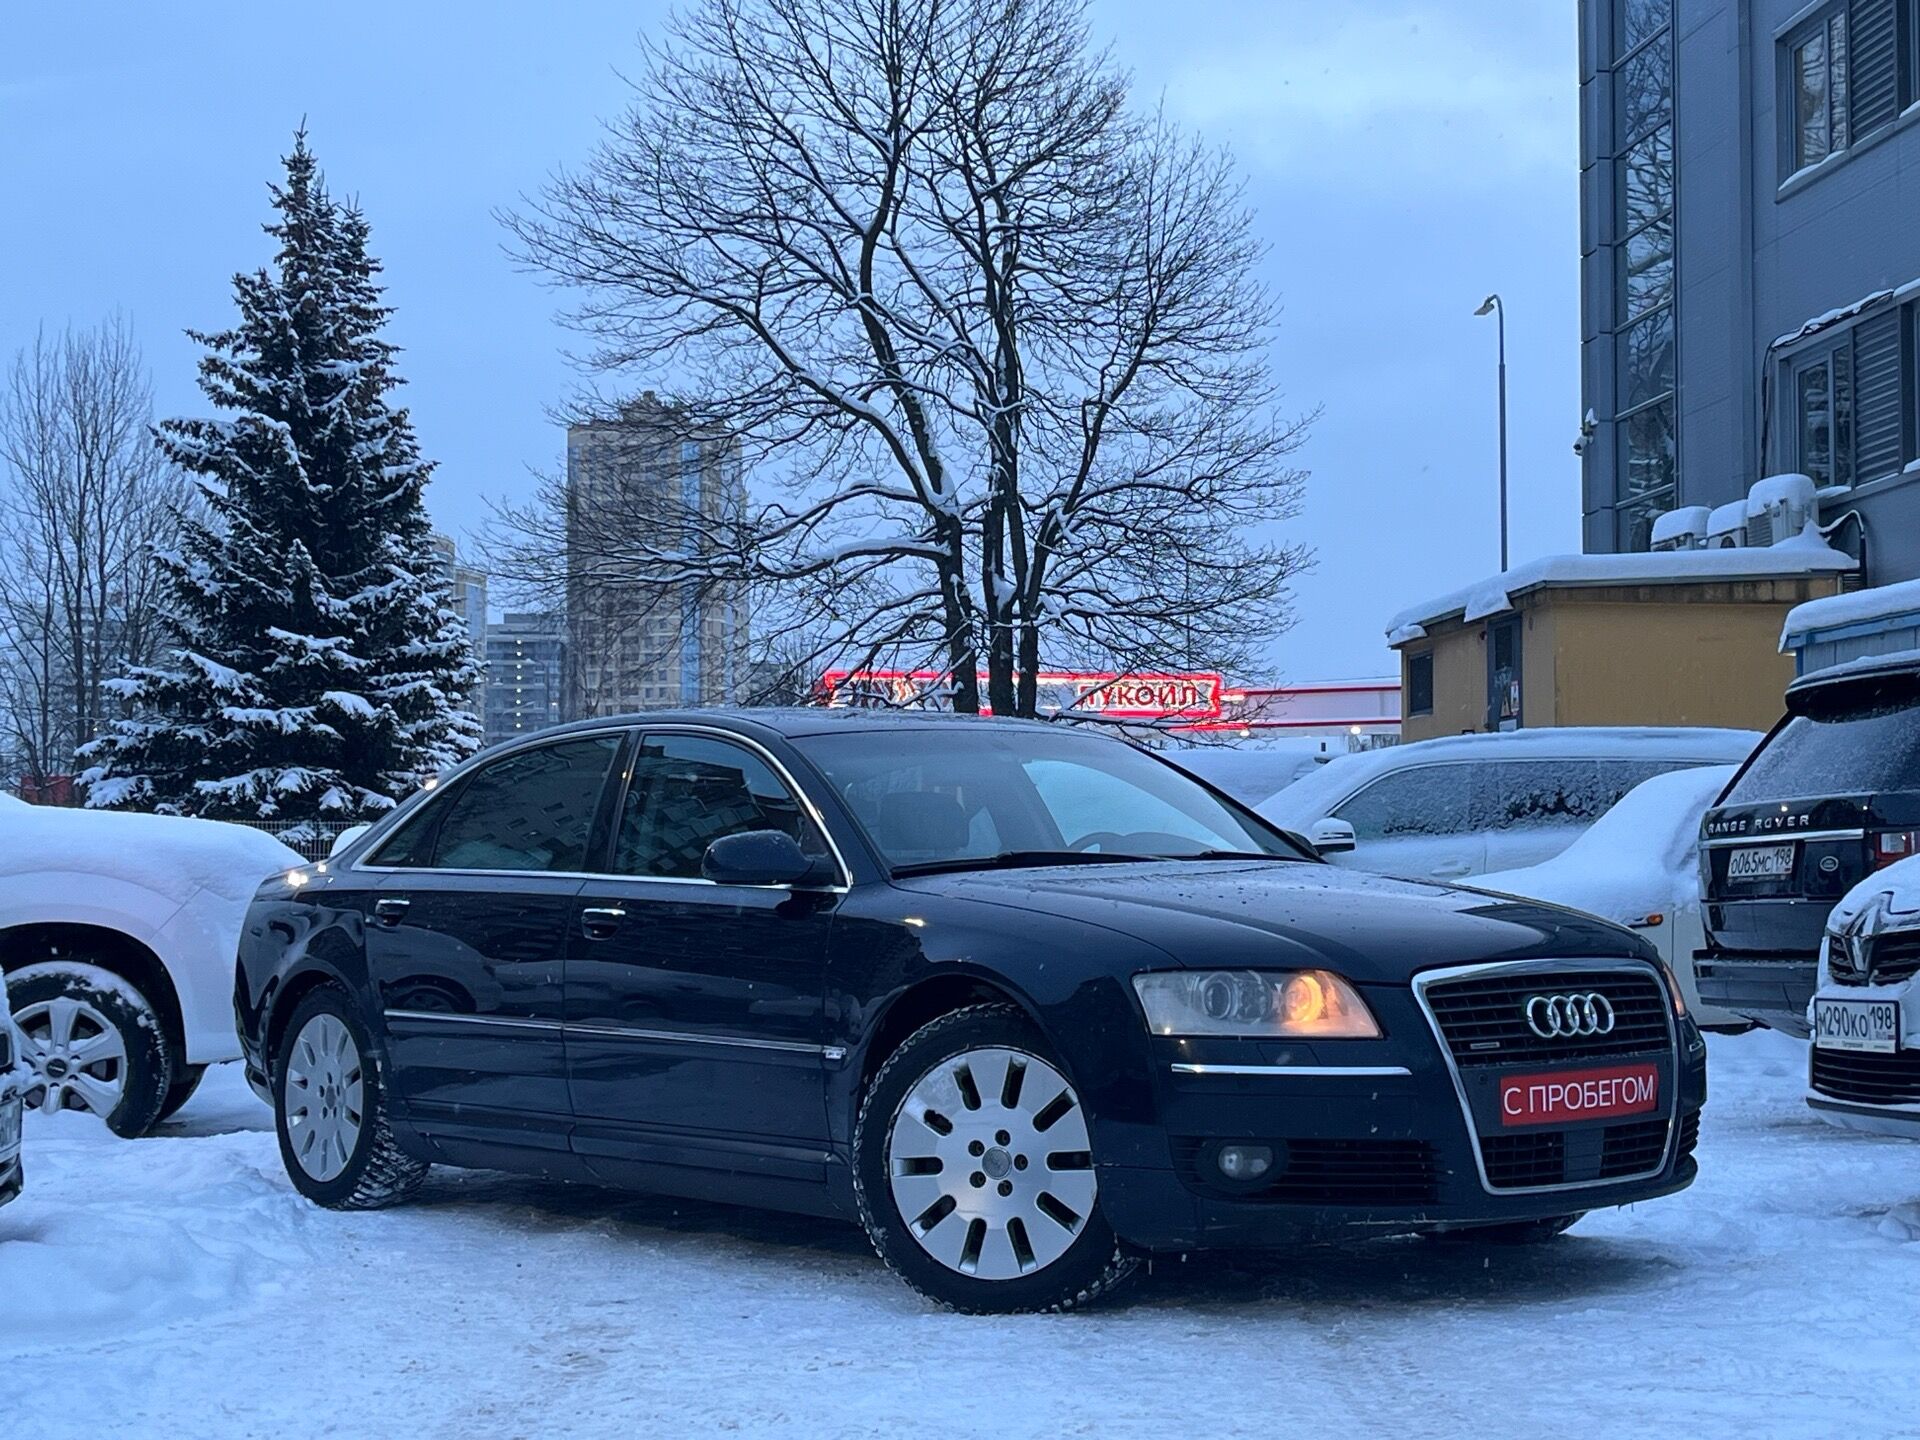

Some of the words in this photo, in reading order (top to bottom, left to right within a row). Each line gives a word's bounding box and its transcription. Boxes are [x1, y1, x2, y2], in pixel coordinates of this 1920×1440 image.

[1707, 820, 1747, 834] RANGE
[1754, 814, 1810, 829] ROVER
[1503, 1086, 1522, 1115] С
[1529, 1074, 1655, 1113] ПРОБЕГОМ
